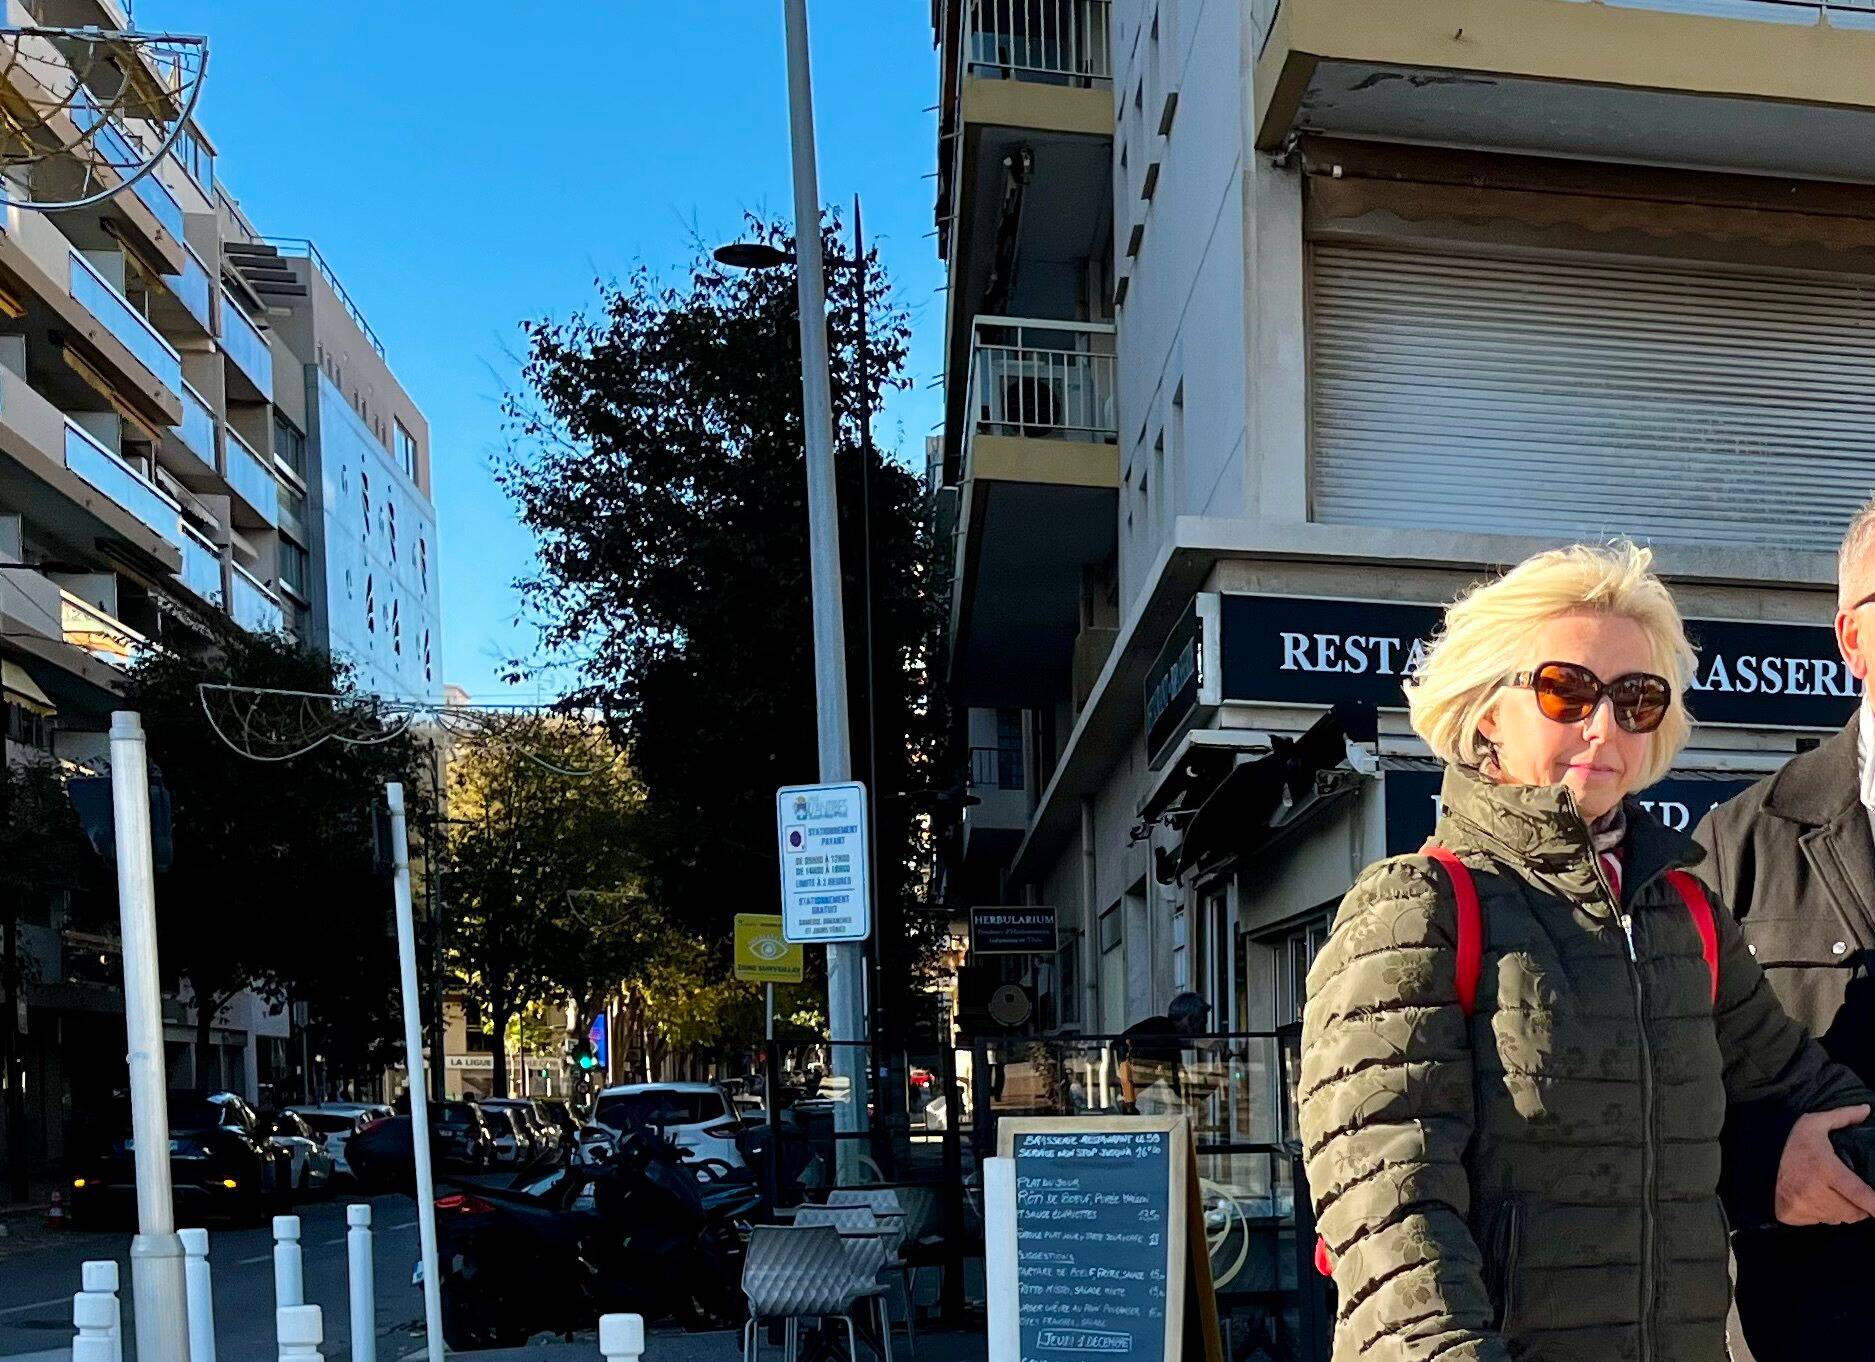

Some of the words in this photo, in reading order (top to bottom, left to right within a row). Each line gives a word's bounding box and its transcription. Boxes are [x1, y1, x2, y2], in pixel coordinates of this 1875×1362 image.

[1279, 632, 1427, 675] RESTA
[1691, 654, 1864, 697] ASSERI
[974, 915, 1054, 925] HERBULARIUM
[450, 1058, 463, 1066] LA
[465, 1059, 492, 1067] LIGUE
